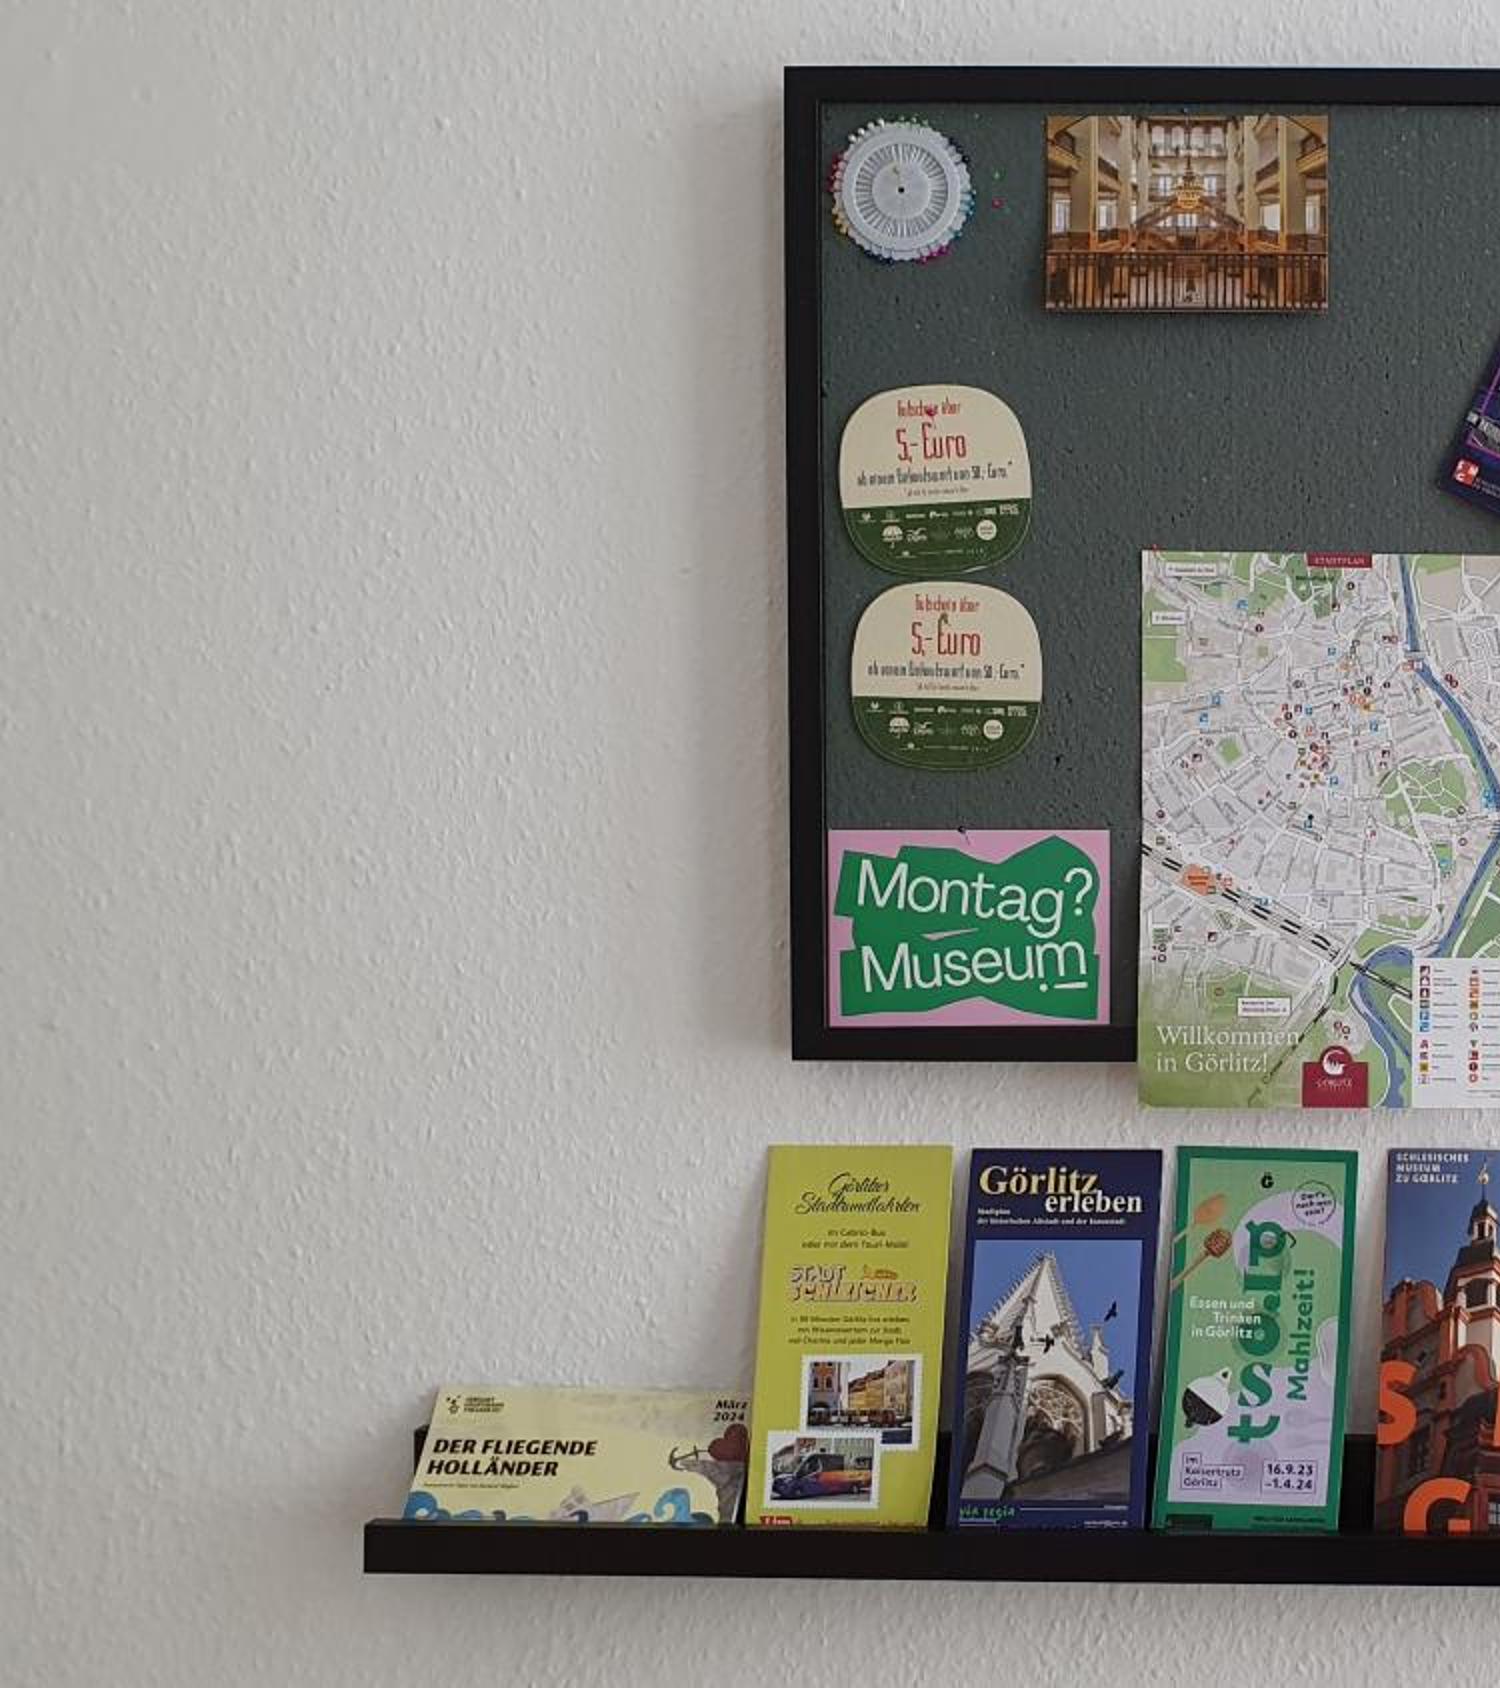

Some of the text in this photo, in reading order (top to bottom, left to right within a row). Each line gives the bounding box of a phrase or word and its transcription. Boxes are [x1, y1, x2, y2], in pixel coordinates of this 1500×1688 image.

[921, 422, 966, 460] Euro
[937, 613, 982, 656] Euro
[857, 859, 1093, 938] Montag?
[1156, 1025, 1301, 1046] Willkommen
[1156, 1052, 1268, 1072] in Görlitz!
[1396, 1153, 1469, 1163] SCHLESISCHES
[1396, 1164, 1441, 1173] MUSEUM
[979, 1166, 1098, 1194] Görlitz
[1395, 1173, 1409, 1183] ZU
[1045, 1189, 1142, 1213] erleben
[1190, 1297, 1255, 1309] Essen und
[1213, 1311, 1261, 1325] Trinken
[1191, 1325, 1253, 1339] in Görlitz
[1286, 1269, 1315, 1401] Mahlzeit!
[715, 1400, 747, 1410] März
[1377, 1360, 1417, 1445] S
[713, 1411, 745, 1421] 2024
[433, 1439, 597, 1456] DER FLIEGENDE
[427, 1457, 558, 1476] HOLLÄNDER
[1185, 1467, 1241, 1477] Kaisertrutz
[1267, 1463, 1314, 1476] 16.9.23
[1183, 1477, 1218, 1487] Görlitz
[1403, 1477, 1472, 1532] G
